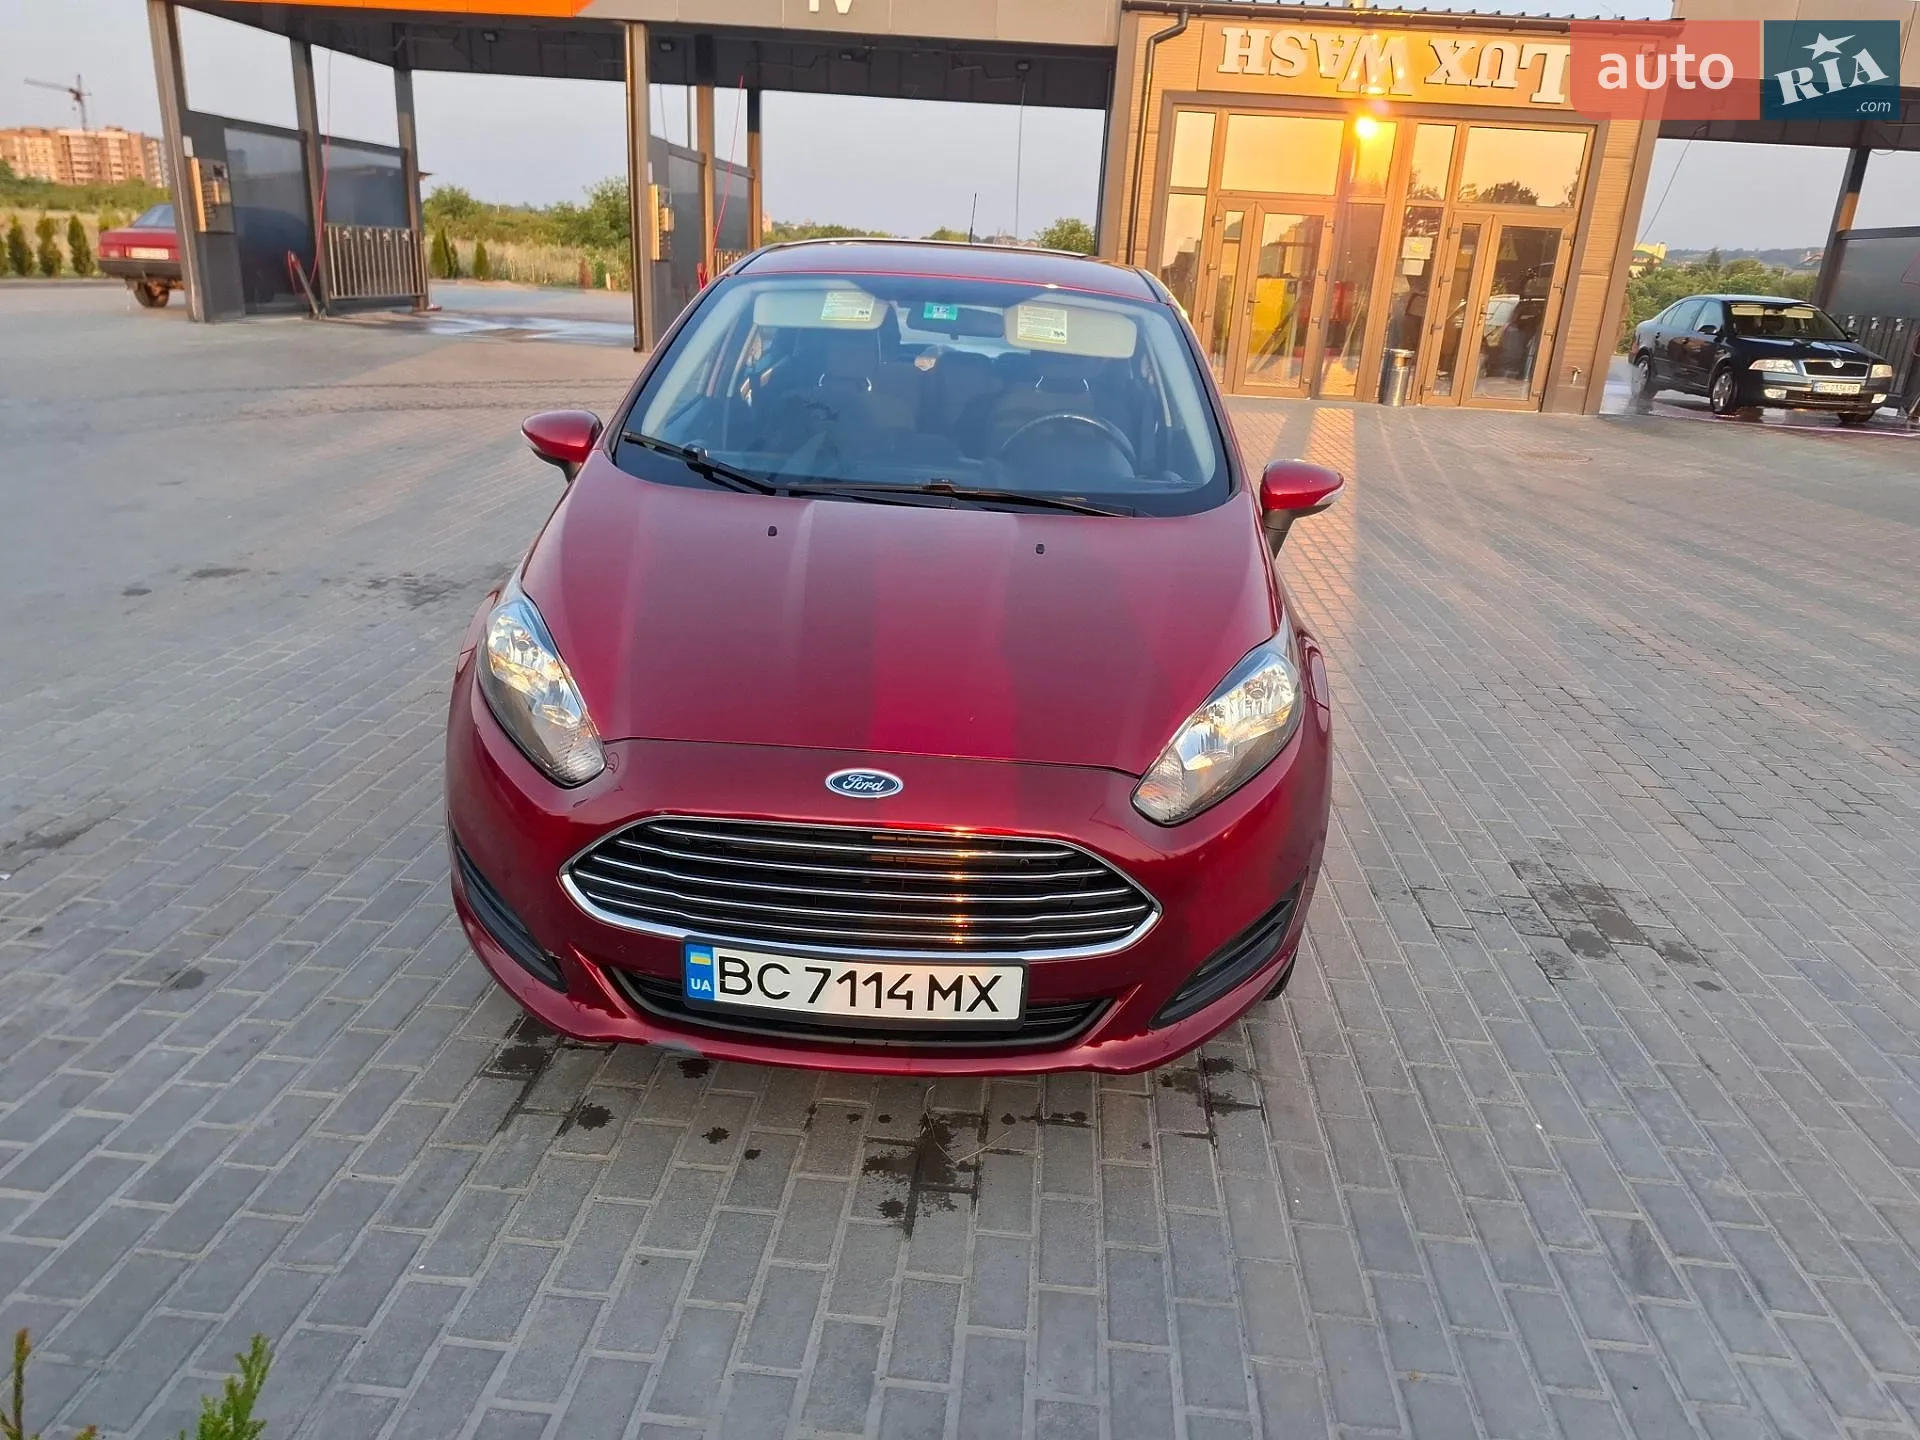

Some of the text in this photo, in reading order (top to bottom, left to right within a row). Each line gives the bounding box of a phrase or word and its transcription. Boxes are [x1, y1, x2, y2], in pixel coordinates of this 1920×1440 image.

[1217, 27, 1571, 104] LUX WASH
[842, 774, 886, 792] Ford
[690, 978, 712, 992] UA
[718, 955, 1002, 1013] BC 7114 MX
